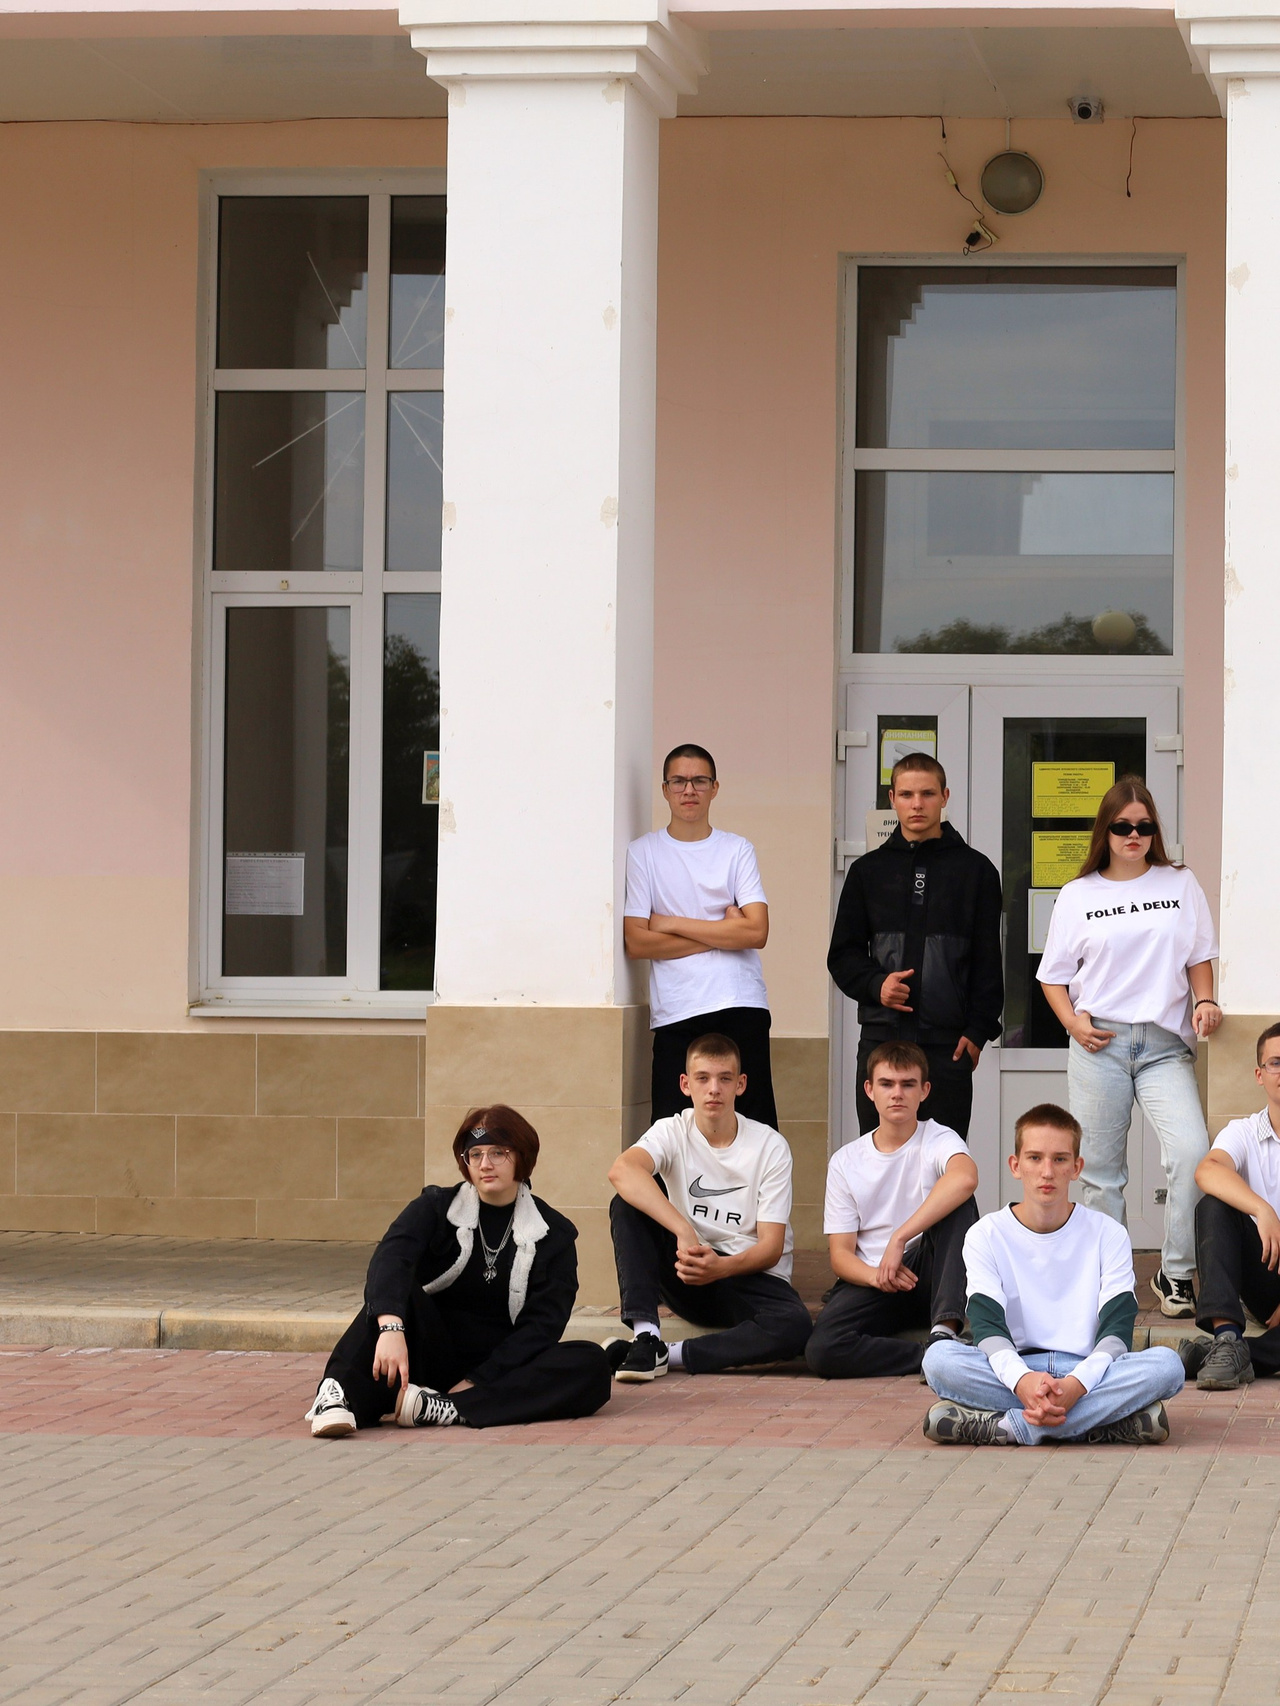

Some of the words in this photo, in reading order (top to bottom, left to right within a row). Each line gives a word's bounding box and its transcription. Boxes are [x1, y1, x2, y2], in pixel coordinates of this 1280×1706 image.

[914, 873, 926, 896] BOY
[1086, 905, 1126, 920] FOLIE
[1130, 901, 1140, 913] À
[1142, 900, 1181, 911] DEUX
[693, 1204, 742, 1226] AIR
